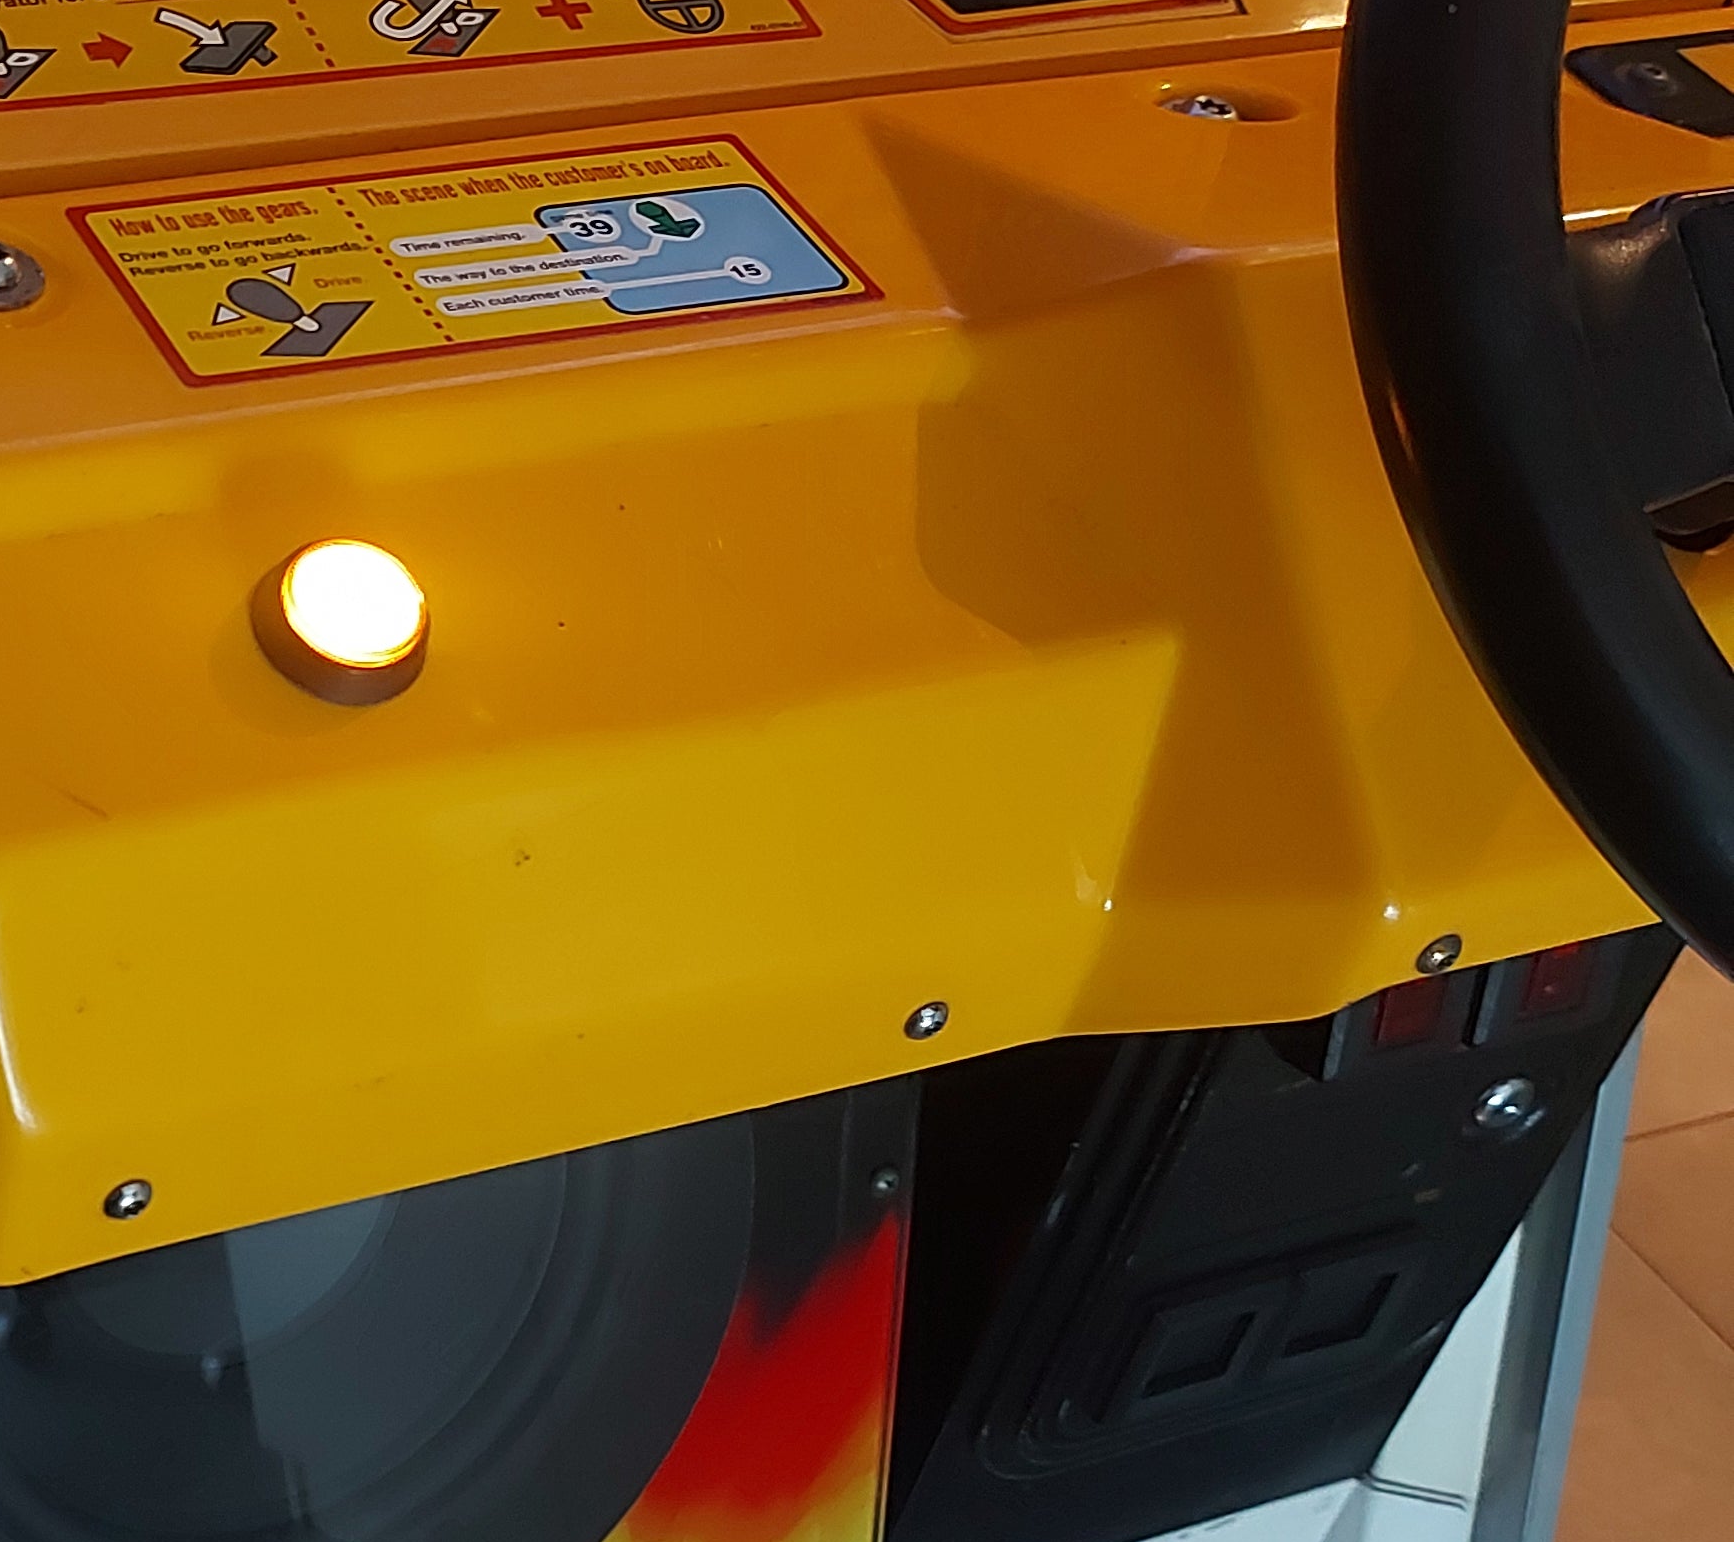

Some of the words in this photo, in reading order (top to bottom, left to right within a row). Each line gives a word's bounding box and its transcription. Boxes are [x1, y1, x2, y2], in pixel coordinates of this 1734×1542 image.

[355, 187, 402, 208] The
[399, 183, 460, 203] scene
[456, 176, 513, 197] when
[507, 170, 545, 191] the
[542, 159, 646, 187] customer's
[643, 158, 672, 176] on
[663, 148, 732, 173] board.
[107, 215, 157, 238] How
[156, 213, 182, 233] to
[181, 209, 218, 230] use
[216, 204, 256, 227] the
[568, 219, 615, 238] 39
[118, 248, 170, 264] Drive
[171, 245, 193, 258] to
[196, 242, 221, 256] go
[223, 231, 313, 251] forwards.
[399, 240, 443, 254] Time
[443, 230, 528, 249] remaining.
[128, 260, 208, 278] Reverse
[209, 257, 231, 269] to
[234, 254, 259, 268] go
[261, 240, 371, 261] backwards.
[419, 273, 454, 286] The
[454, 269, 488, 282] way
[488, 265, 509, 277] to
[508, 262, 537, 274] the
[538, 251, 630, 272] destination.
[728, 260, 764, 280] 15
[442, 297, 487, 312] Each
[487, 288, 562, 307] customer
[562, 283, 606, 298] time.
